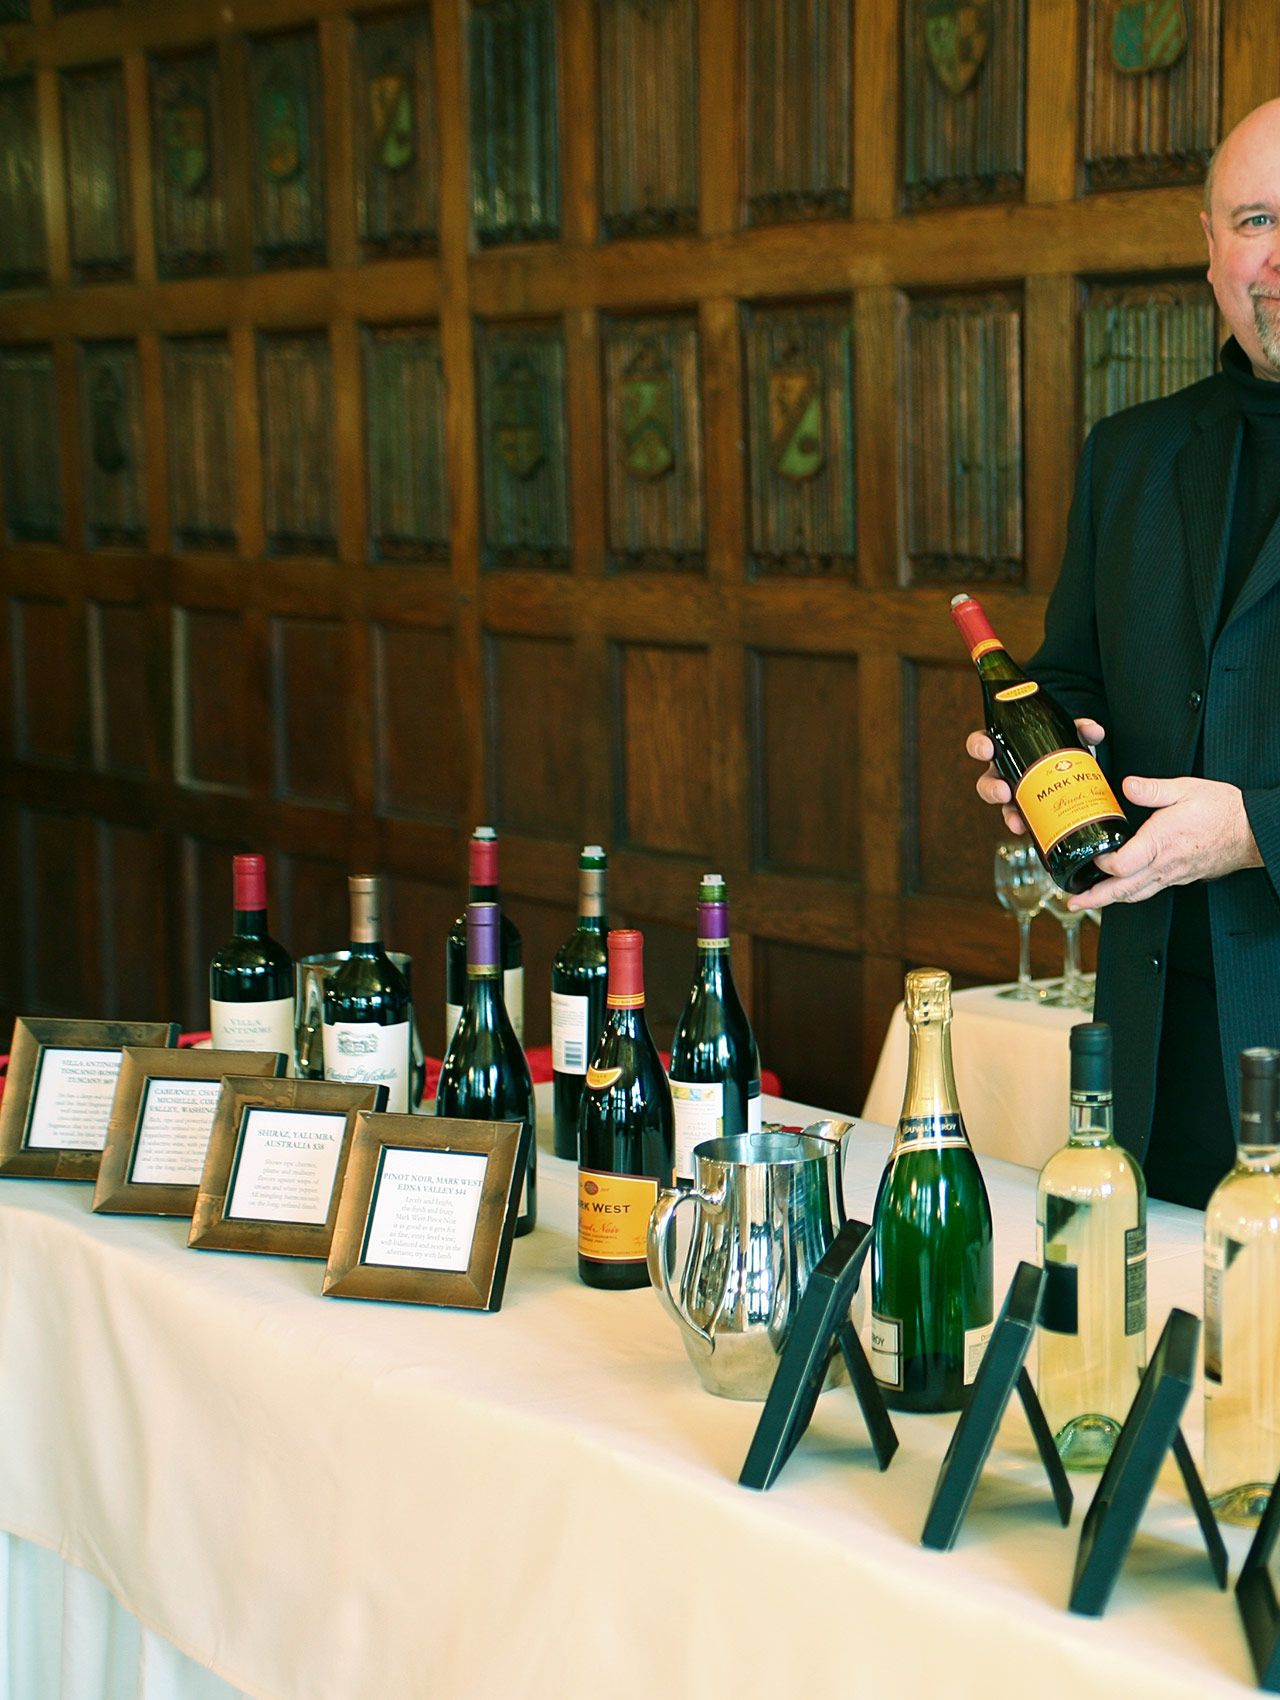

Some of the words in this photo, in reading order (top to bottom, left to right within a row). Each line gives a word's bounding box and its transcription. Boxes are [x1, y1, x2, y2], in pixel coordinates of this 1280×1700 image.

[1036, 778, 1071, 803] MARK
[903, 1122, 957, 1135] DUVAL-LROY
[257, 1129, 291, 1139] SHIRAZ,
[292, 1131, 335, 1142] YALUMBA,
[264, 1140, 311, 1149] AUSTRALIA
[383, 1172, 410, 1181] PINOT
[411, 1174, 434, 1184] NOIR,
[436, 1176, 459, 1185] MARK
[460, 1178, 483, 1187] WEST
[397, 1183, 421, 1192] EDNA
[423, 1185, 454, 1194] VALLEY
[592, 1203, 631, 1214] WEST
